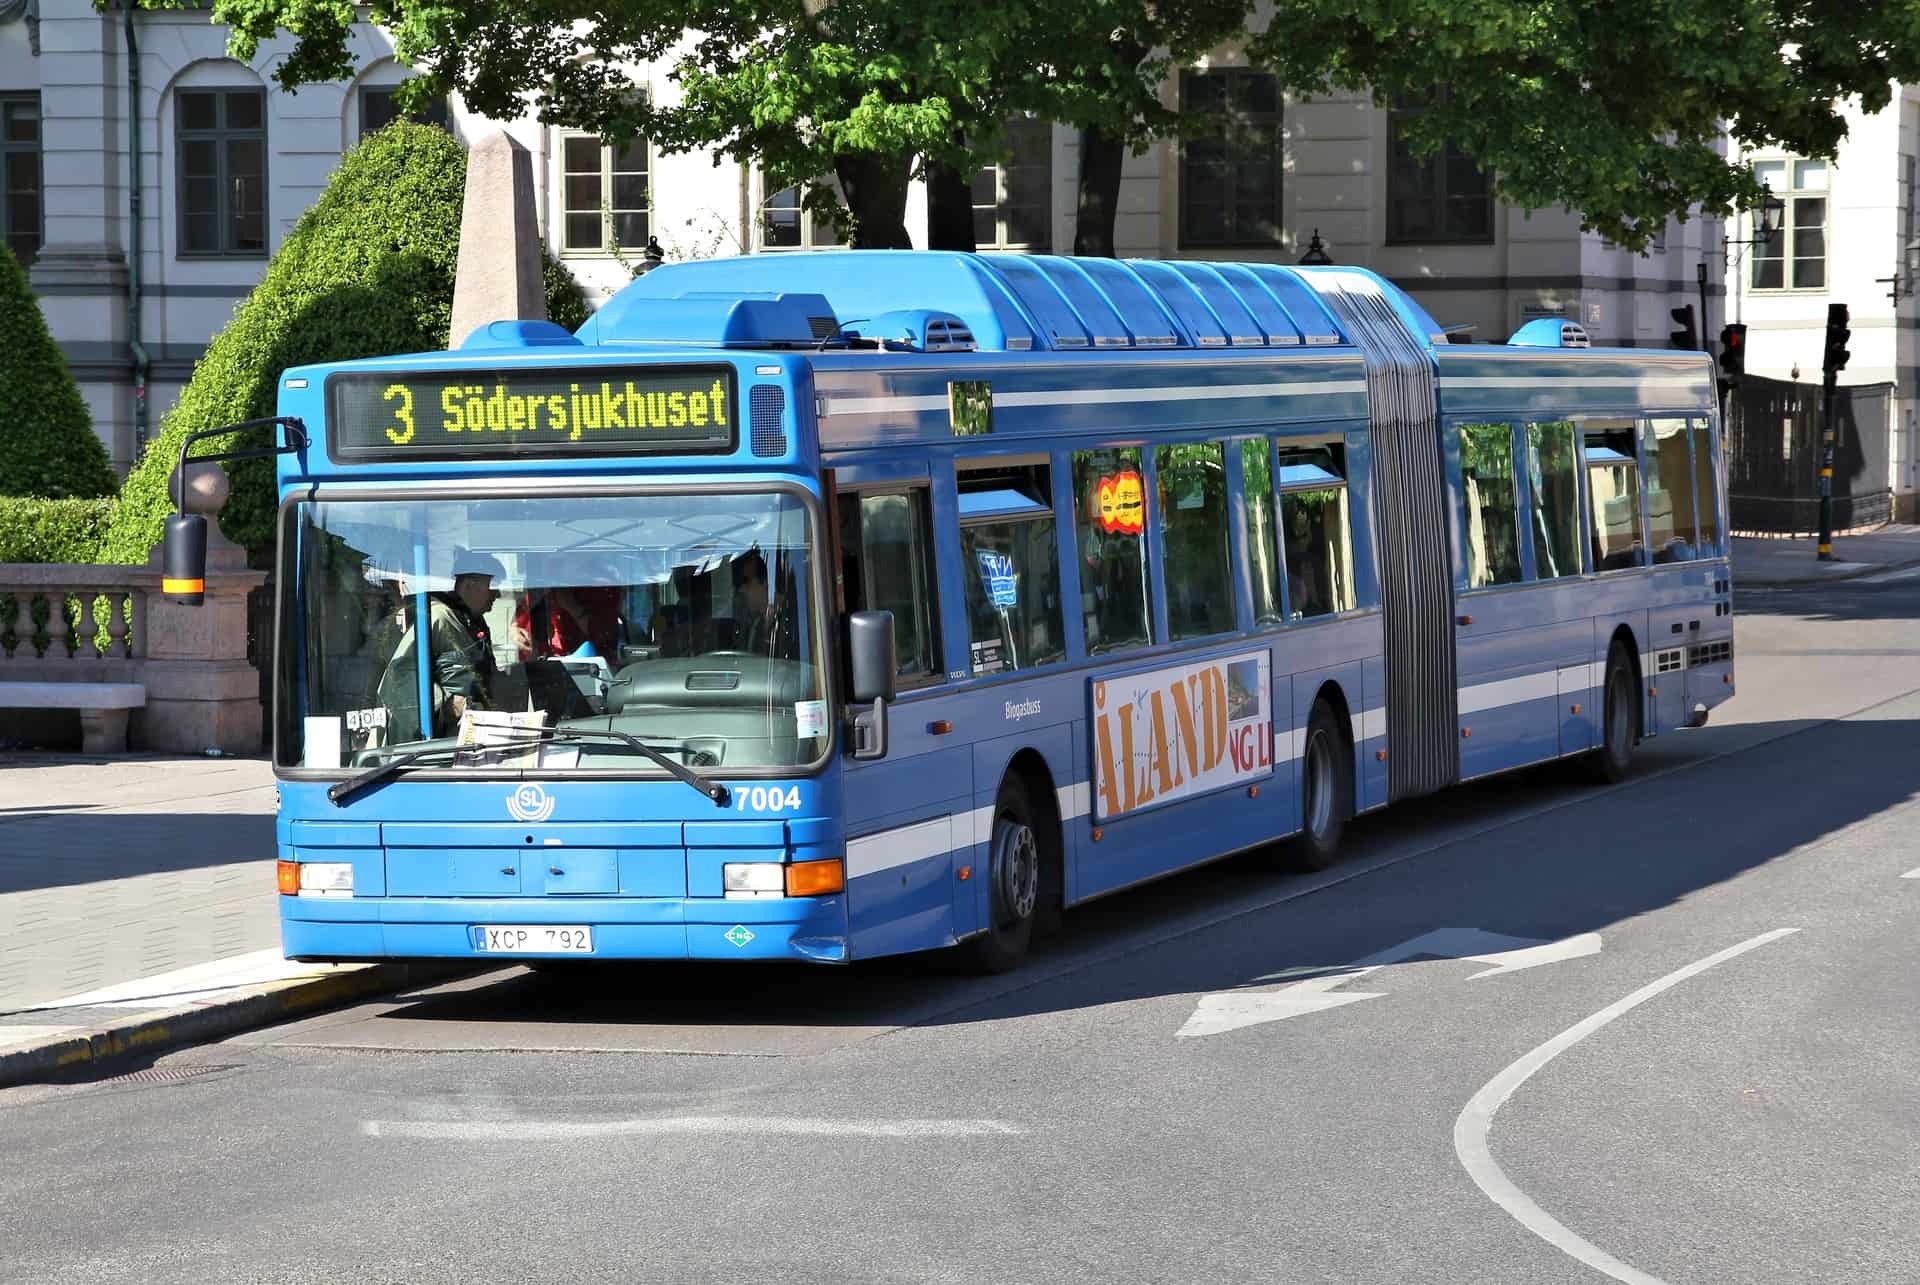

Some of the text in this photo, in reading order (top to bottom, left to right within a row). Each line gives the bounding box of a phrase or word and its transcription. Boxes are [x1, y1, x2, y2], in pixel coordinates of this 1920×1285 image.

[384, 379, 726, 444] 3 Södersjukhuset
[1006, 698, 1040, 720] Biogasbuss
[520, 790, 544, 807] SL
[734, 785, 802, 812] 7004
[489, 930, 586, 949] XCP 792
